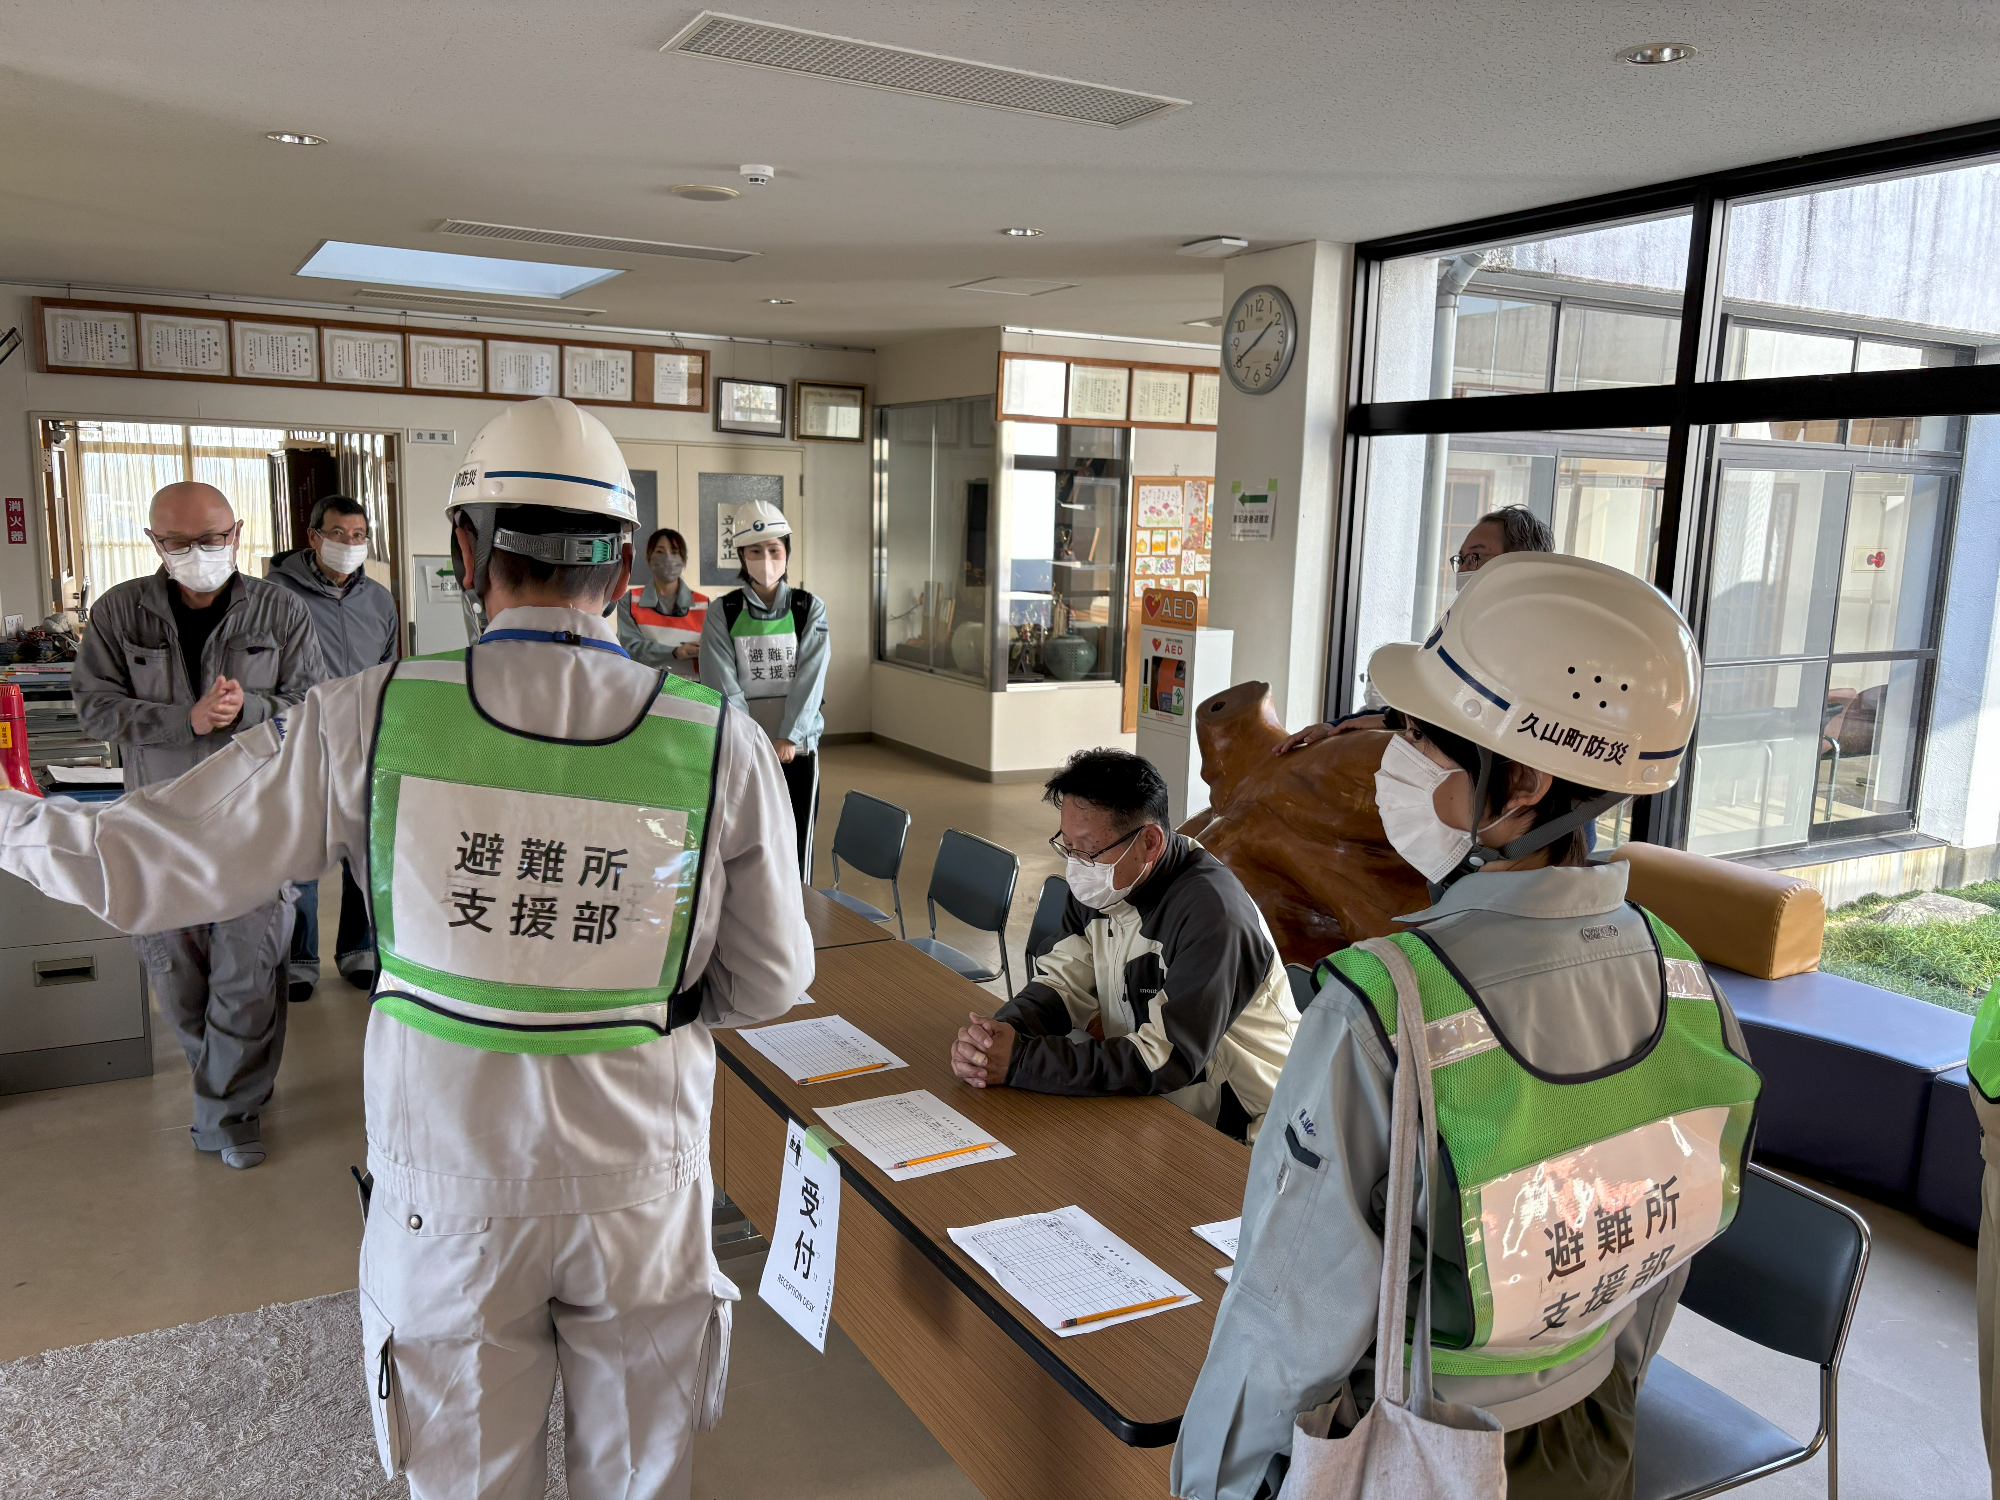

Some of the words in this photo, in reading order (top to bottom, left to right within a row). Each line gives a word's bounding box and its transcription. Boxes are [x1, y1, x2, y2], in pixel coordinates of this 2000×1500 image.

[1245, 303, 1253, 318] 11
[1256, 298, 1264, 312] 12
[1275, 312, 1282, 325] 2
[1233, 337, 1240, 350] 9
[1277, 330, 1285, 344] 3
[1273, 350, 1280, 362] 4
[1245, 366, 1251, 379] 7
[1253, 369, 1260, 382] 6
[1264, 363, 1272, 377] 5
[416, 431, 449, 441] 会議室
[8, 500, 23, 542] 消火器
[721, 515, 739, 560] 立入禁止
[1161, 596, 1196, 620] AED
[1164, 643, 1183, 656] AED
[1516, 712, 1630, 766] 久山町防災
[454, 830, 629, 891] 避難所
[448, 887, 621, 945] 支援部
[794, 1175, 820, 1280] 受付
[1543, 1174, 1680, 1283] 避難所
[776, 1273, 803, 1302] RECEPTION
[802, 1296, 816, 1313] DESK
[1529, 1243, 1676, 1341] 支援部
